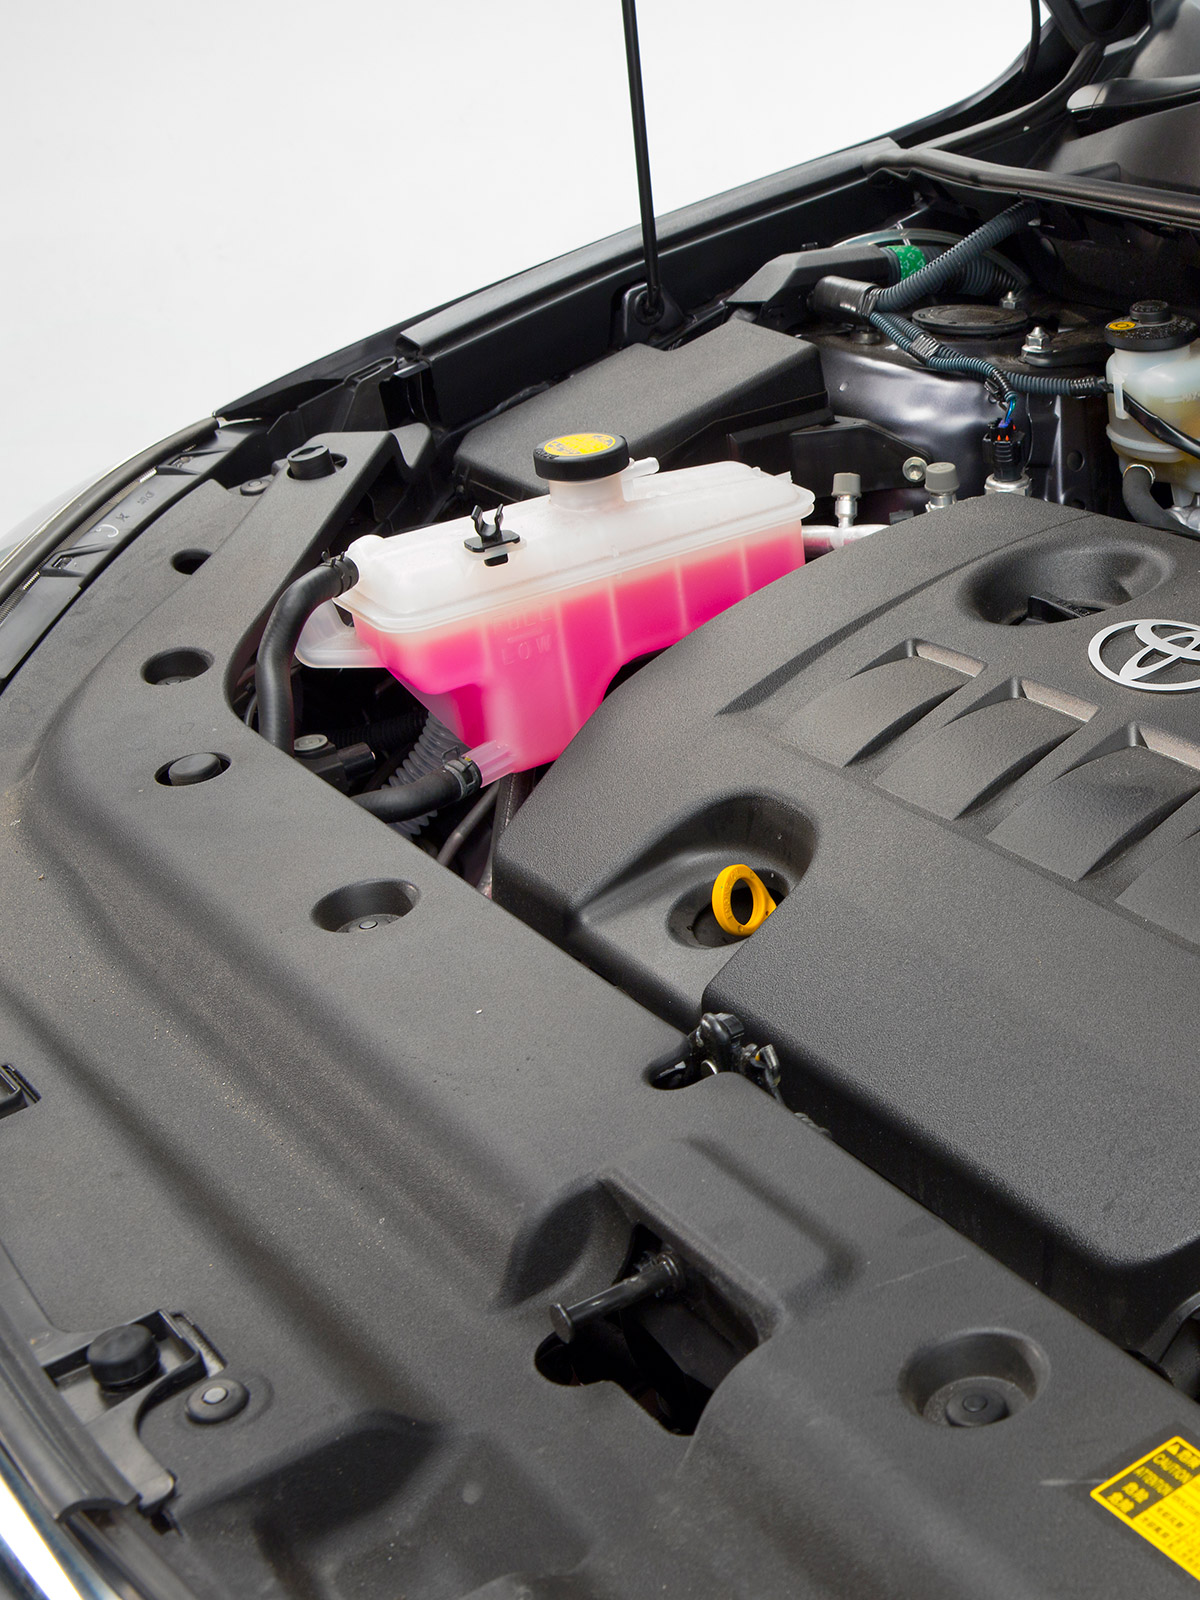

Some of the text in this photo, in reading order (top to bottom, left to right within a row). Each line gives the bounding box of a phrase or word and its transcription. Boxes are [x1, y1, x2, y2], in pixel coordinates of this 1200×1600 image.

[501, 634, 553, 666] LOW
[1133, 1466, 1173, 1496] ATTENTION
[1152, 1453, 1192, 1484] CAUTION
